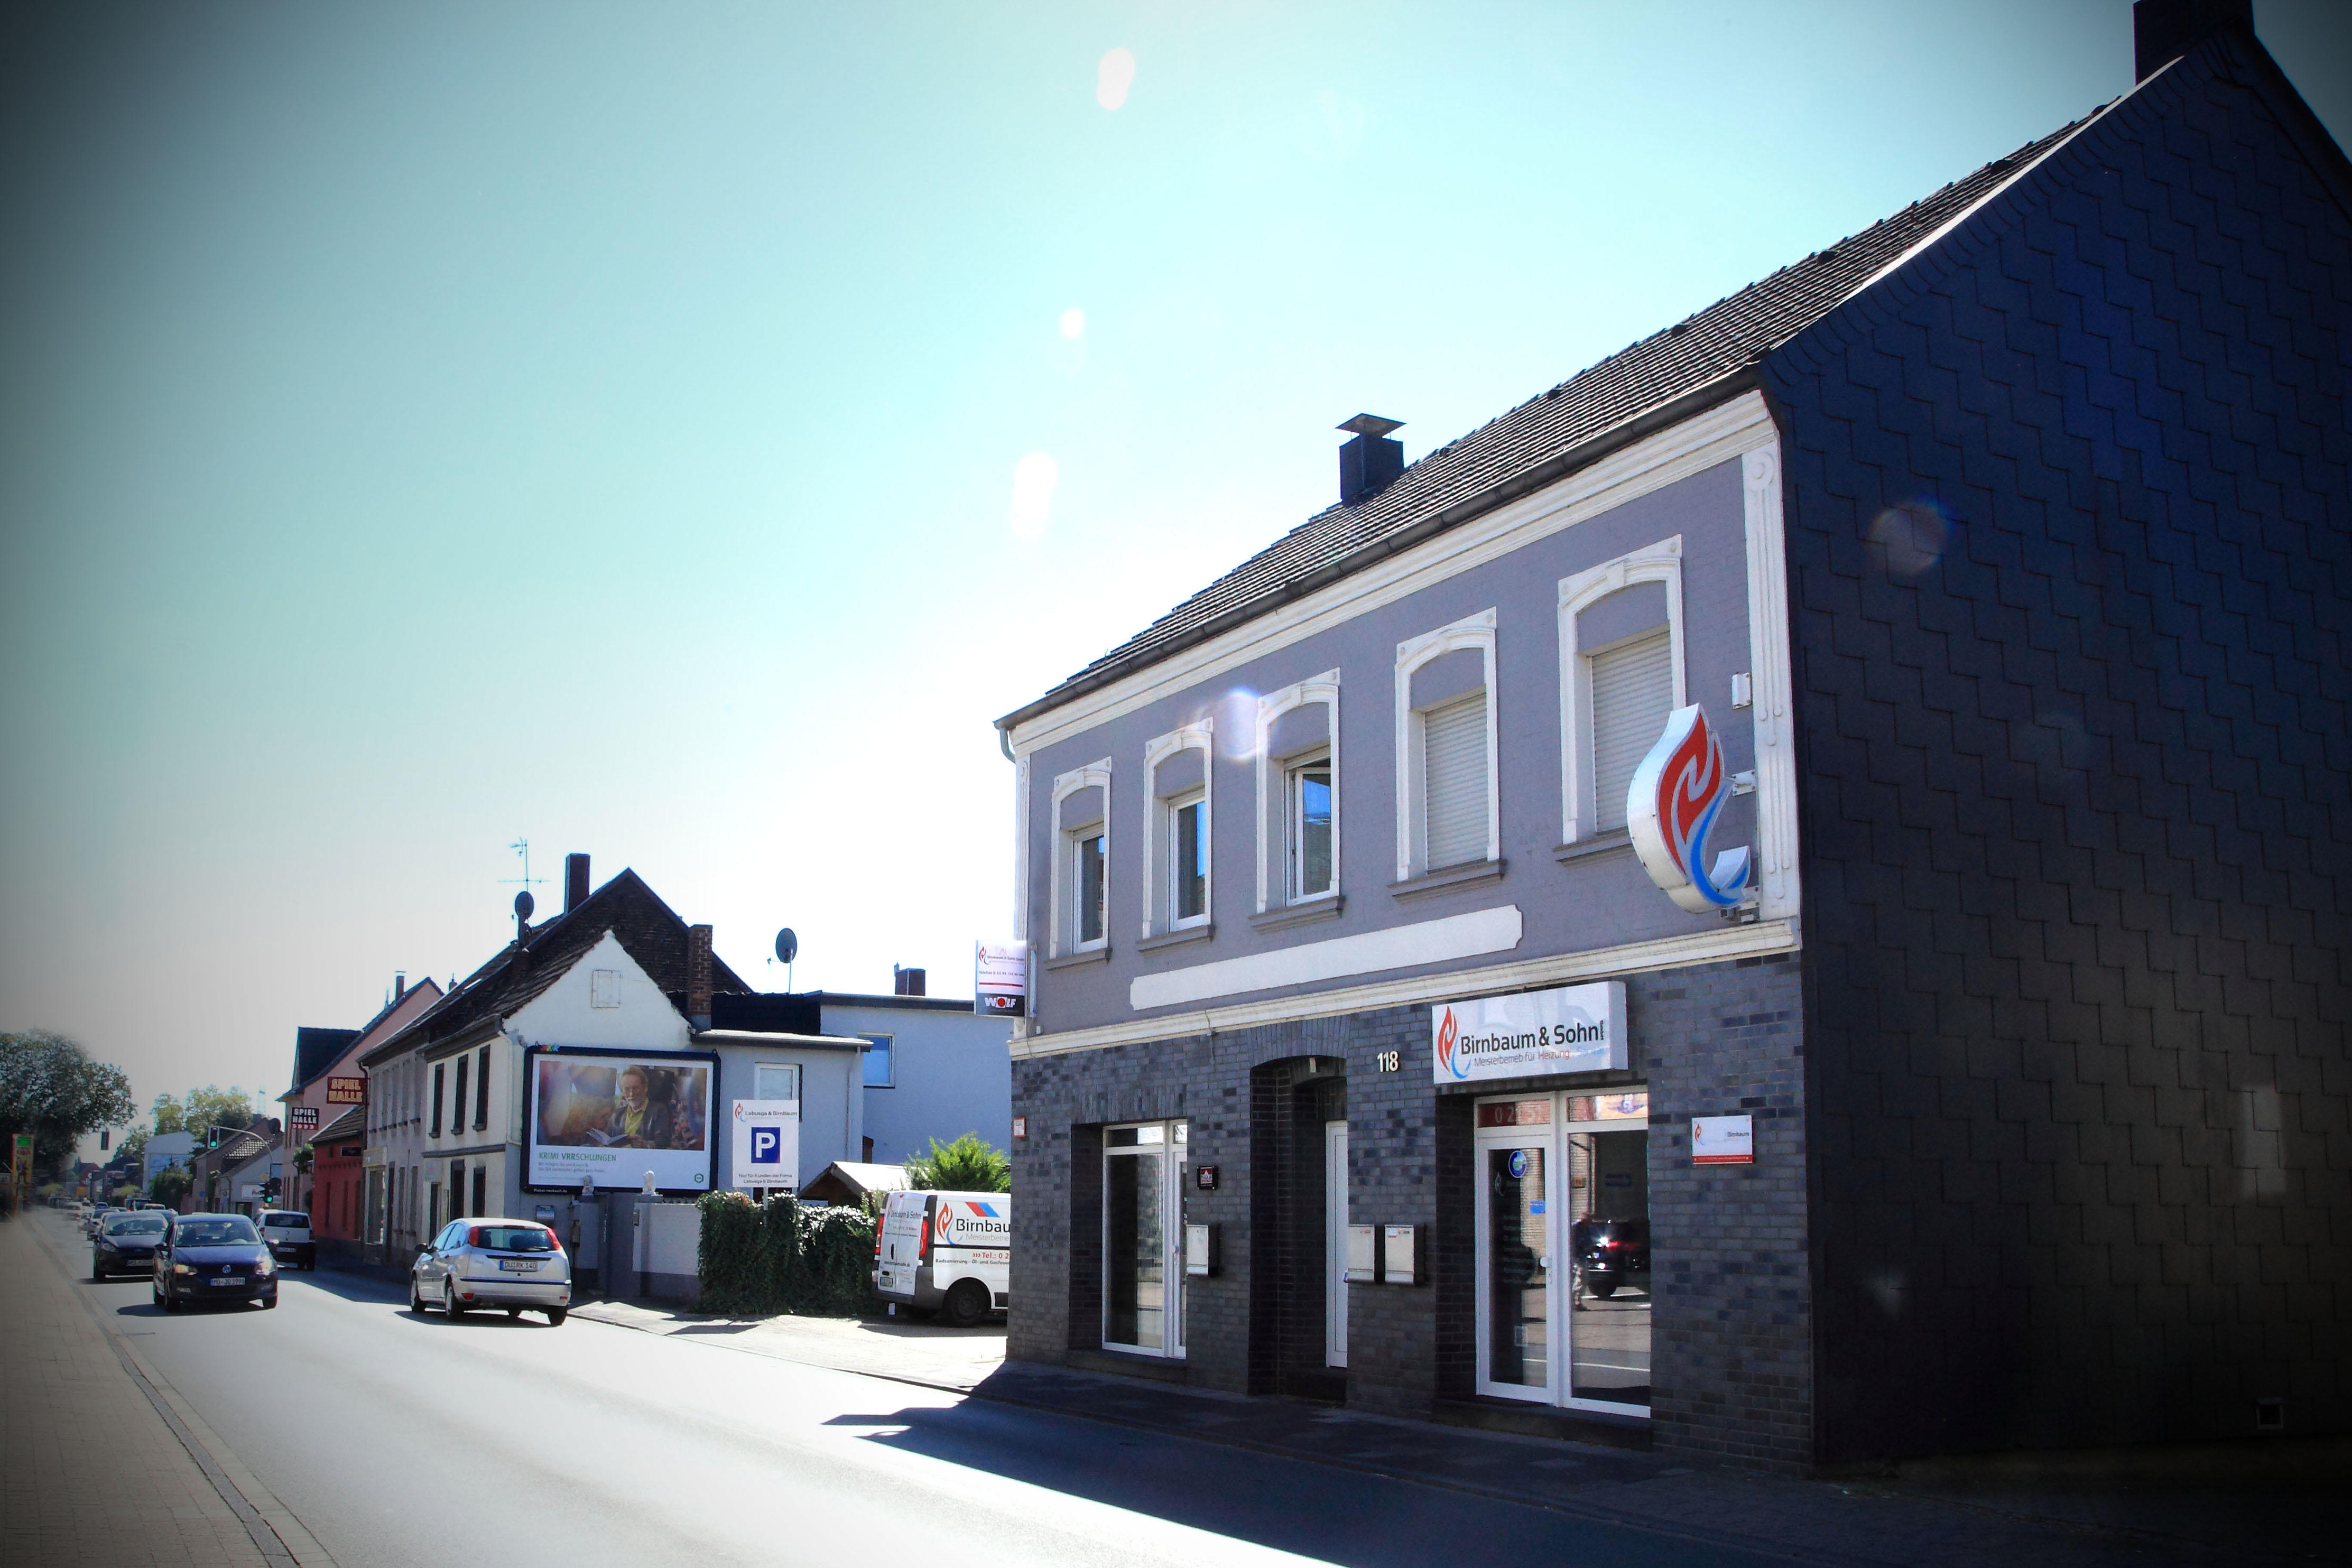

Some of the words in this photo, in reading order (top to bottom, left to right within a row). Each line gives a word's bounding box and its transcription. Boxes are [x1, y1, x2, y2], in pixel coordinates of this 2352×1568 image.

[984, 997, 1016, 1008] WOLF
[1461, 1033, 1535, 1055] Birnbaum
[1539, 1026, 1549, 1046] &
[1554, 1022, 1598, 1045] Sohn
[1377, 1051, 1399, 1072] 118
[1474, 1054, 1523, 1066] Meisterbetrieb
[1525, 1052, 1535, 1061] für
[1538, 1050, 1569, 1060] Heizung
[331, 1079, 360, 1090] SPIEL
[329, 1091, 363, 1102] HALLE
[756, 1133, 775, 1158] P
[956, 1219, 1010, 1233] Birnbau
